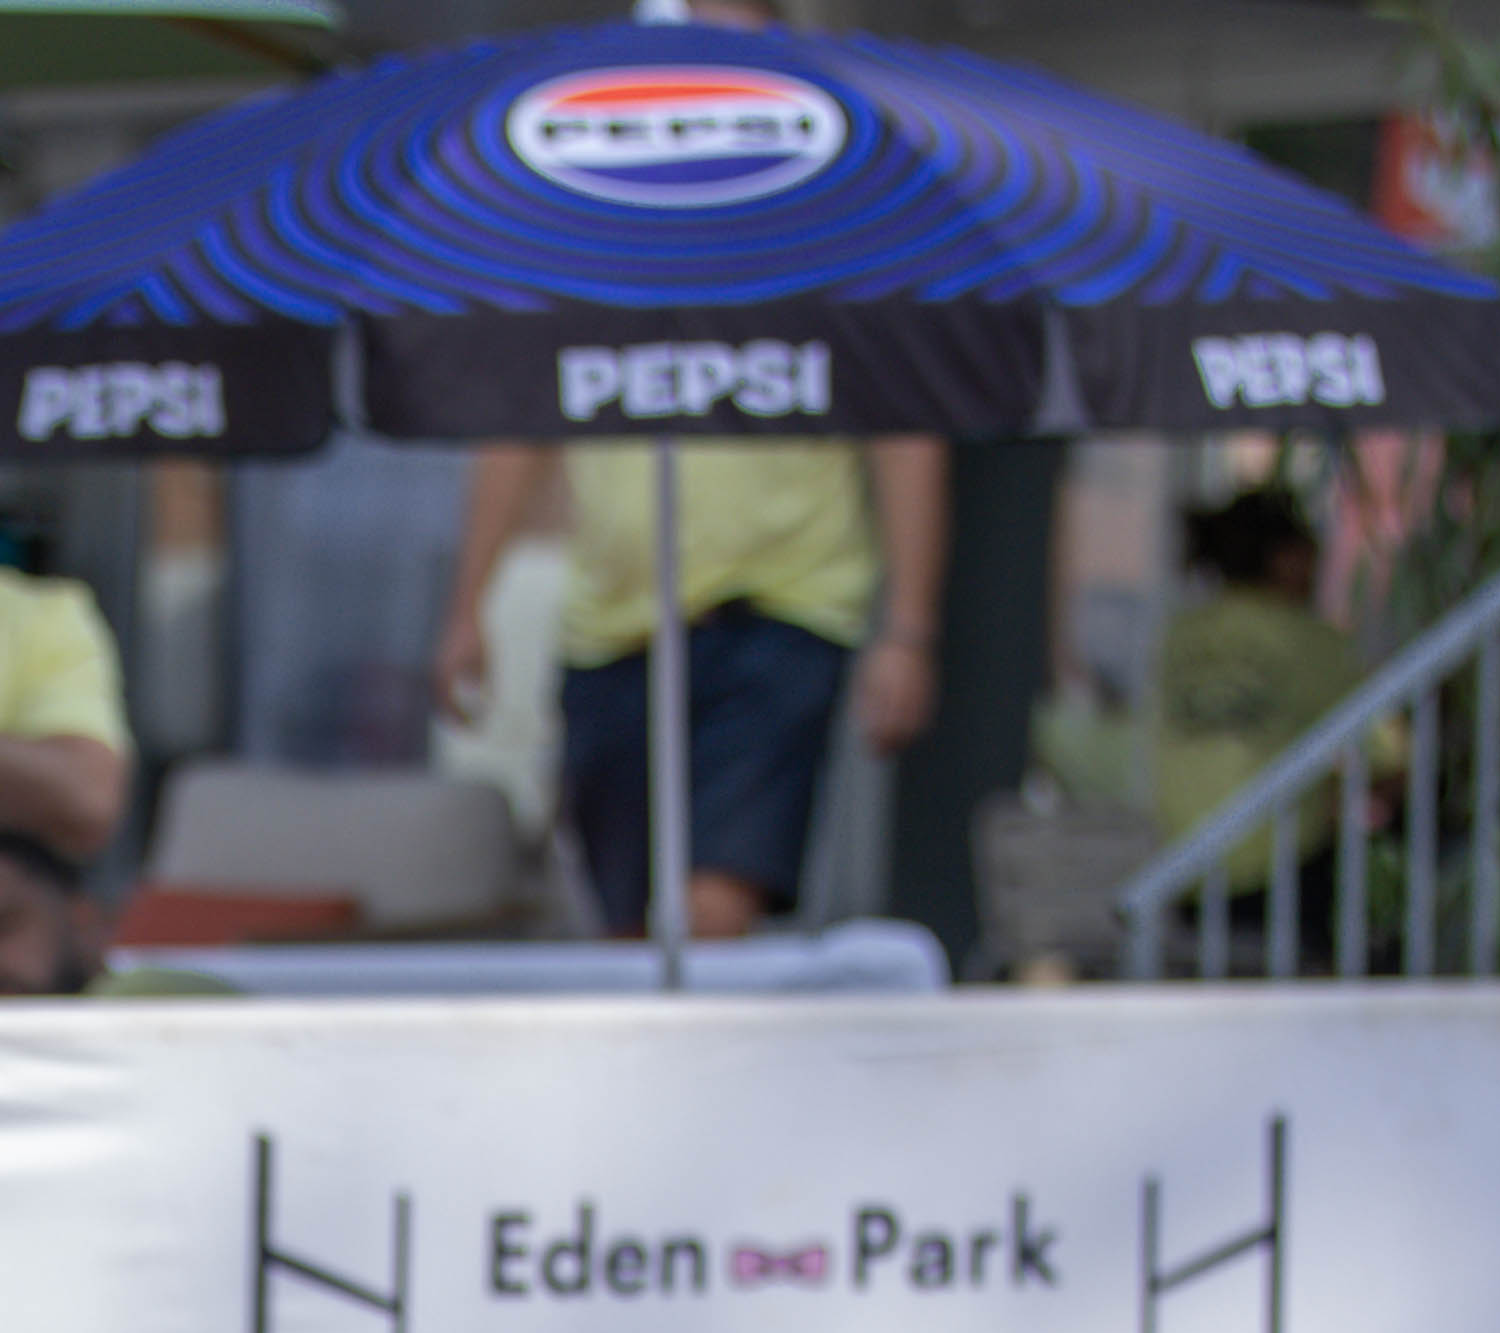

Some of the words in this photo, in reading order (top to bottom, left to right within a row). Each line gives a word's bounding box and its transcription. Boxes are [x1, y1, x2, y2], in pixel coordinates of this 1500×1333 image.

[540, 114, 812, 146] PEPSI
[18, 364, 222, 440] PEPSI
[561, 343, 830, 420] PEPSI
[1195, 334, 1385, 407] PEPSI
[487, 1203, 707, 1297] Eden
[852, 1193, 1058, 1289] Park
